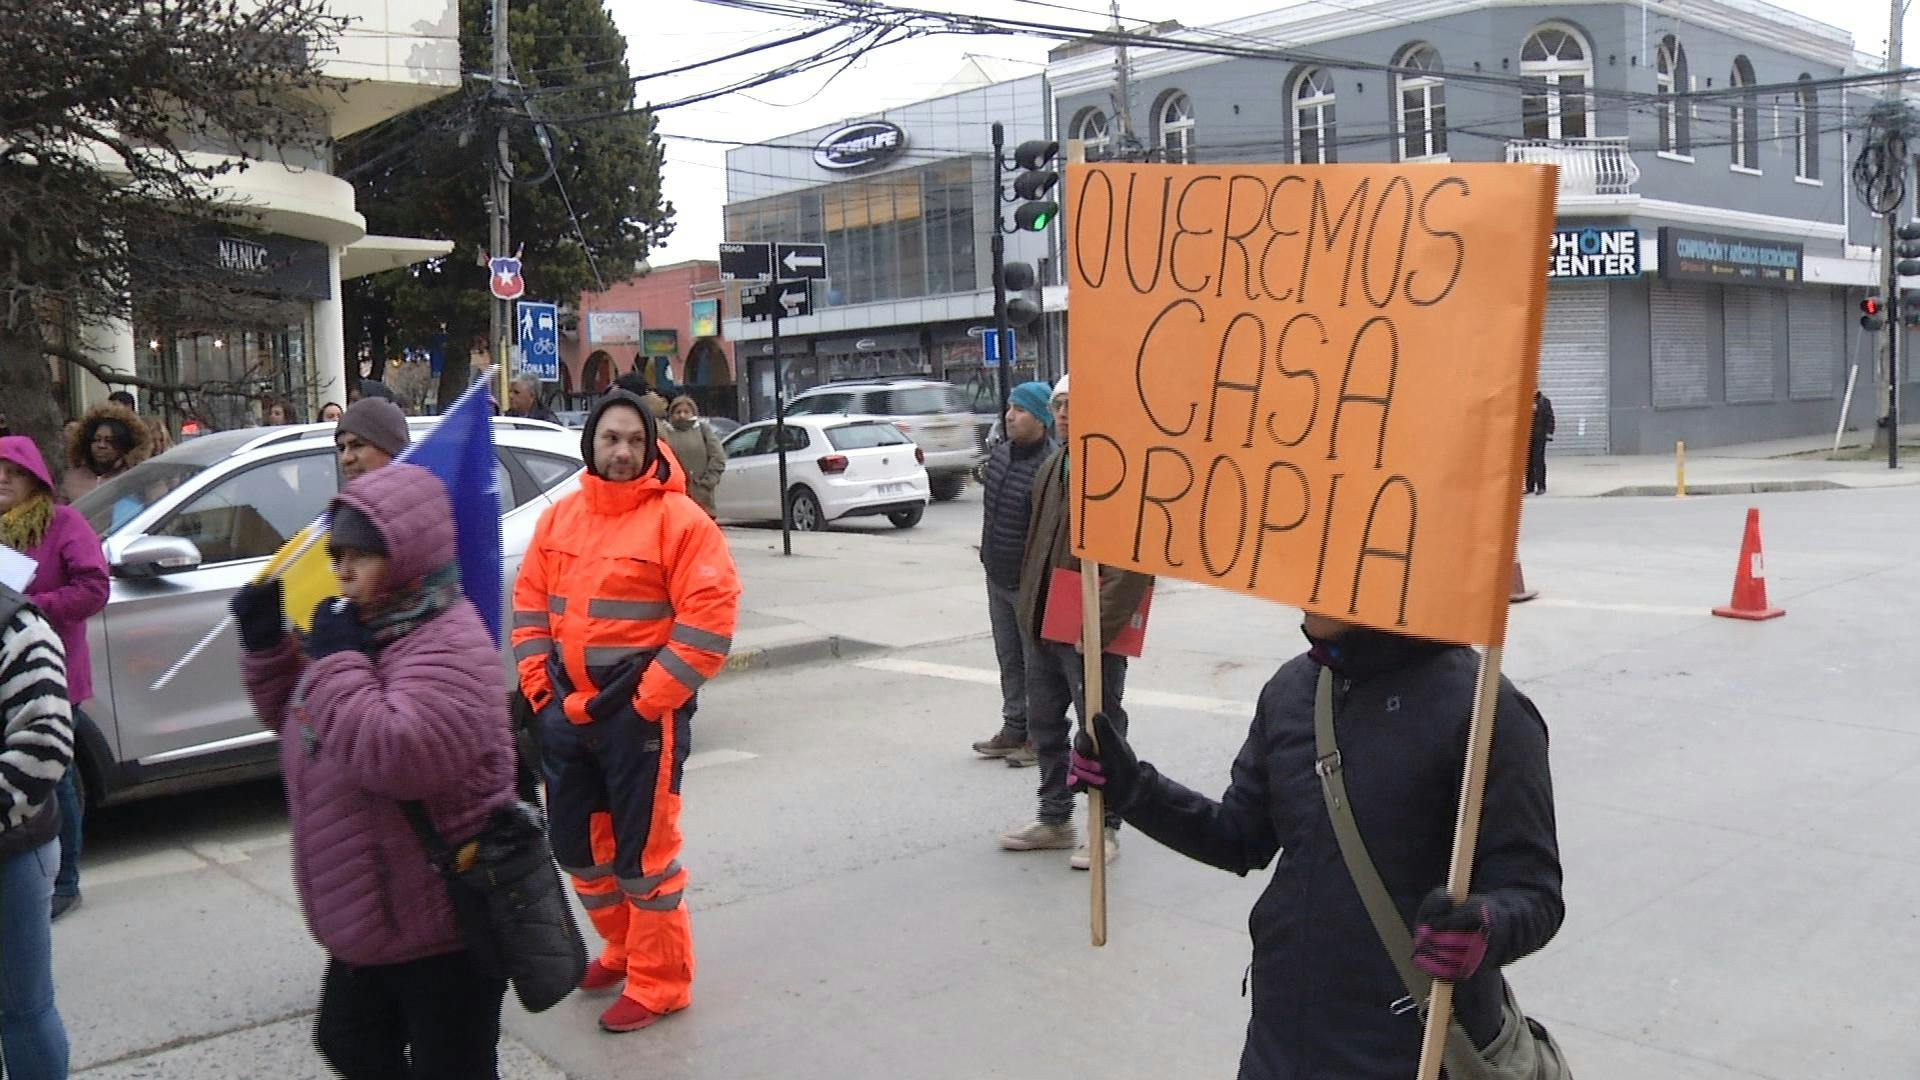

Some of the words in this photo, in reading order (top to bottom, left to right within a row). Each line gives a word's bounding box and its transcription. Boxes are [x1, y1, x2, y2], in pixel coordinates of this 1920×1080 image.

[1546, 254, 1635, 277] CENTER
[1135, 298, 1398, 470] CASA
[1077, 433, 1418, 626] PROPIA
